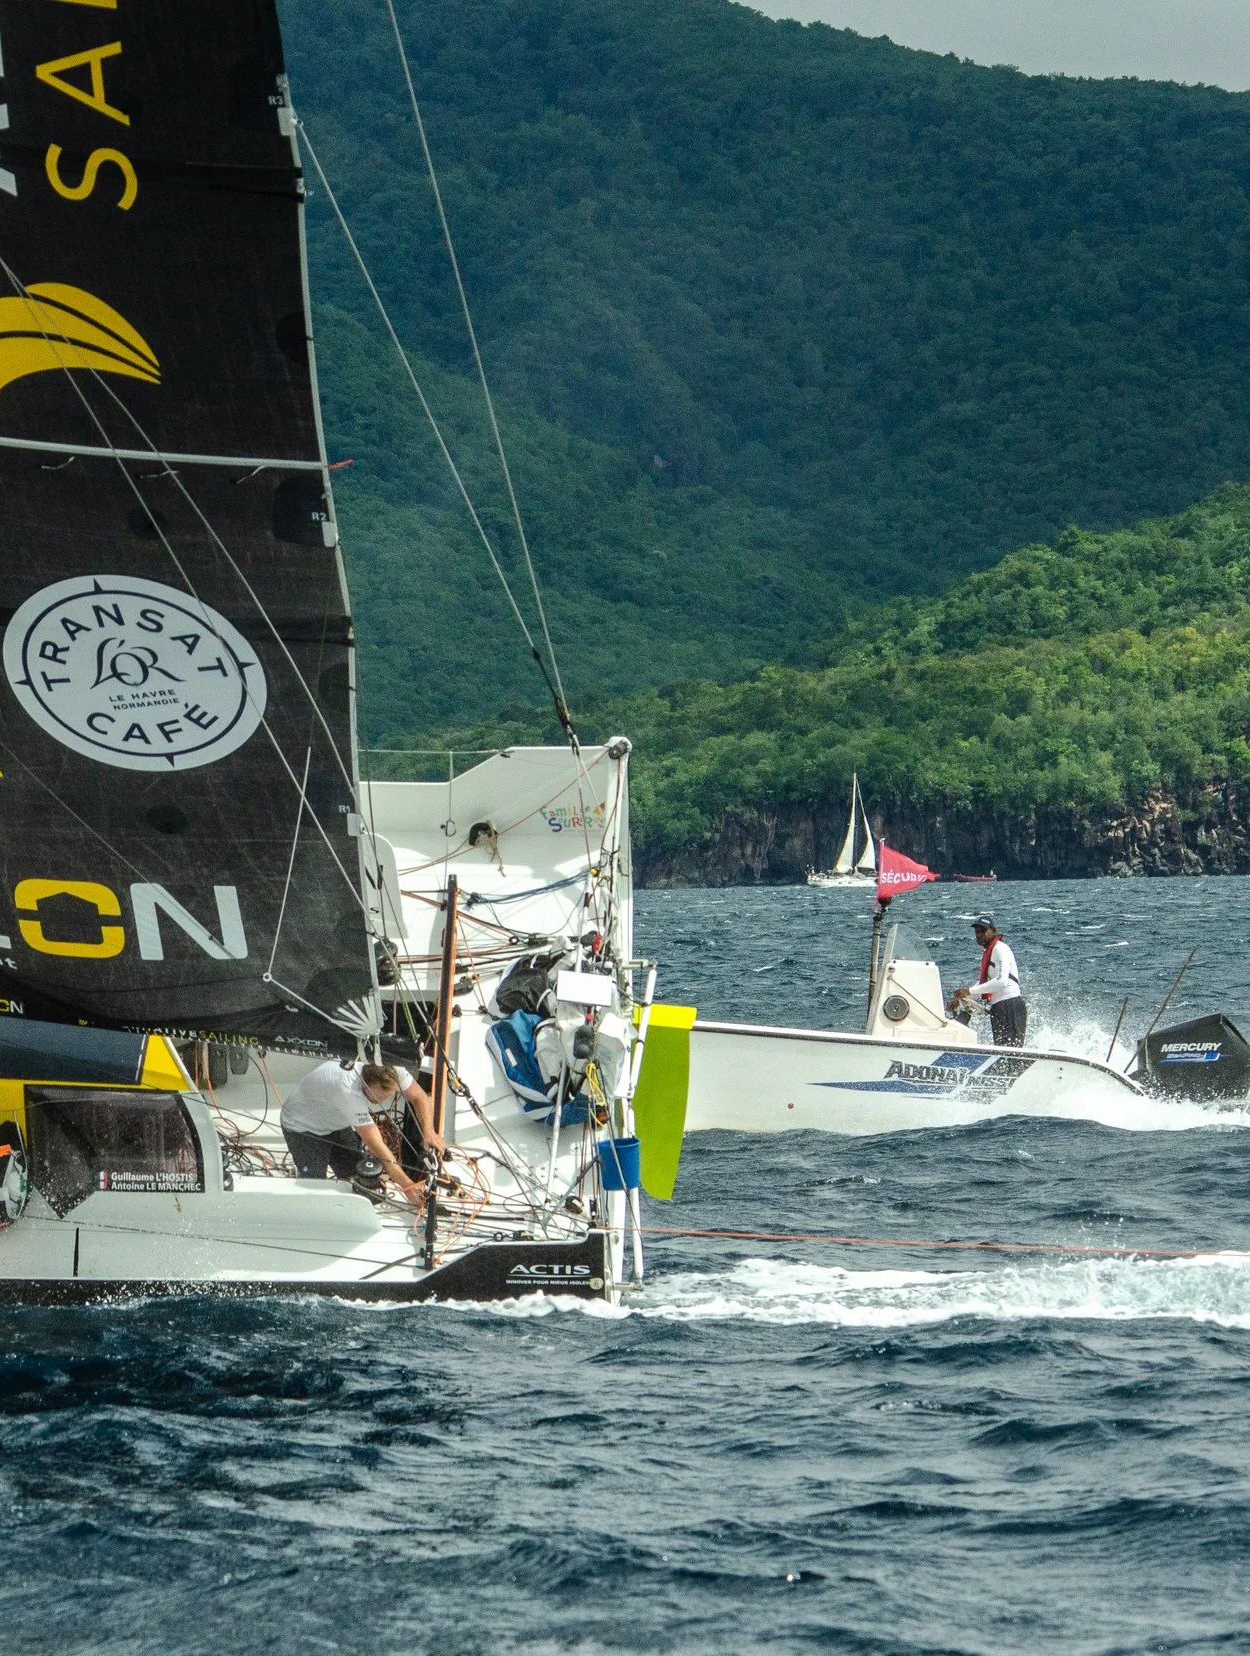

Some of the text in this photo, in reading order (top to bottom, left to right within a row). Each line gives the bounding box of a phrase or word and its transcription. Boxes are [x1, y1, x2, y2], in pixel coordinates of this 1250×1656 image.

[268, 95, 284, 106] R3
[311, 511, 327, 521] R2
[39, 603, 229, 692] TRANSAT
[109, 689, 176, 703] LE HAVRE
[113, 697, 180, 711] NORMANDIE
[86, 702, 219, 745] CAFÉ
[338, 804, 350, 813] R1
[275, 1035, 328, 1048] AXXON
[1161, 1043, 1222, 1052] MERCURY
[111, 1172, 193, 1182] Guillaume L'HOSTIS
[111, 1182, 201, 1191] Antoine LE MANCHEC
[510, 1264, 590, 1274] ACTIS
